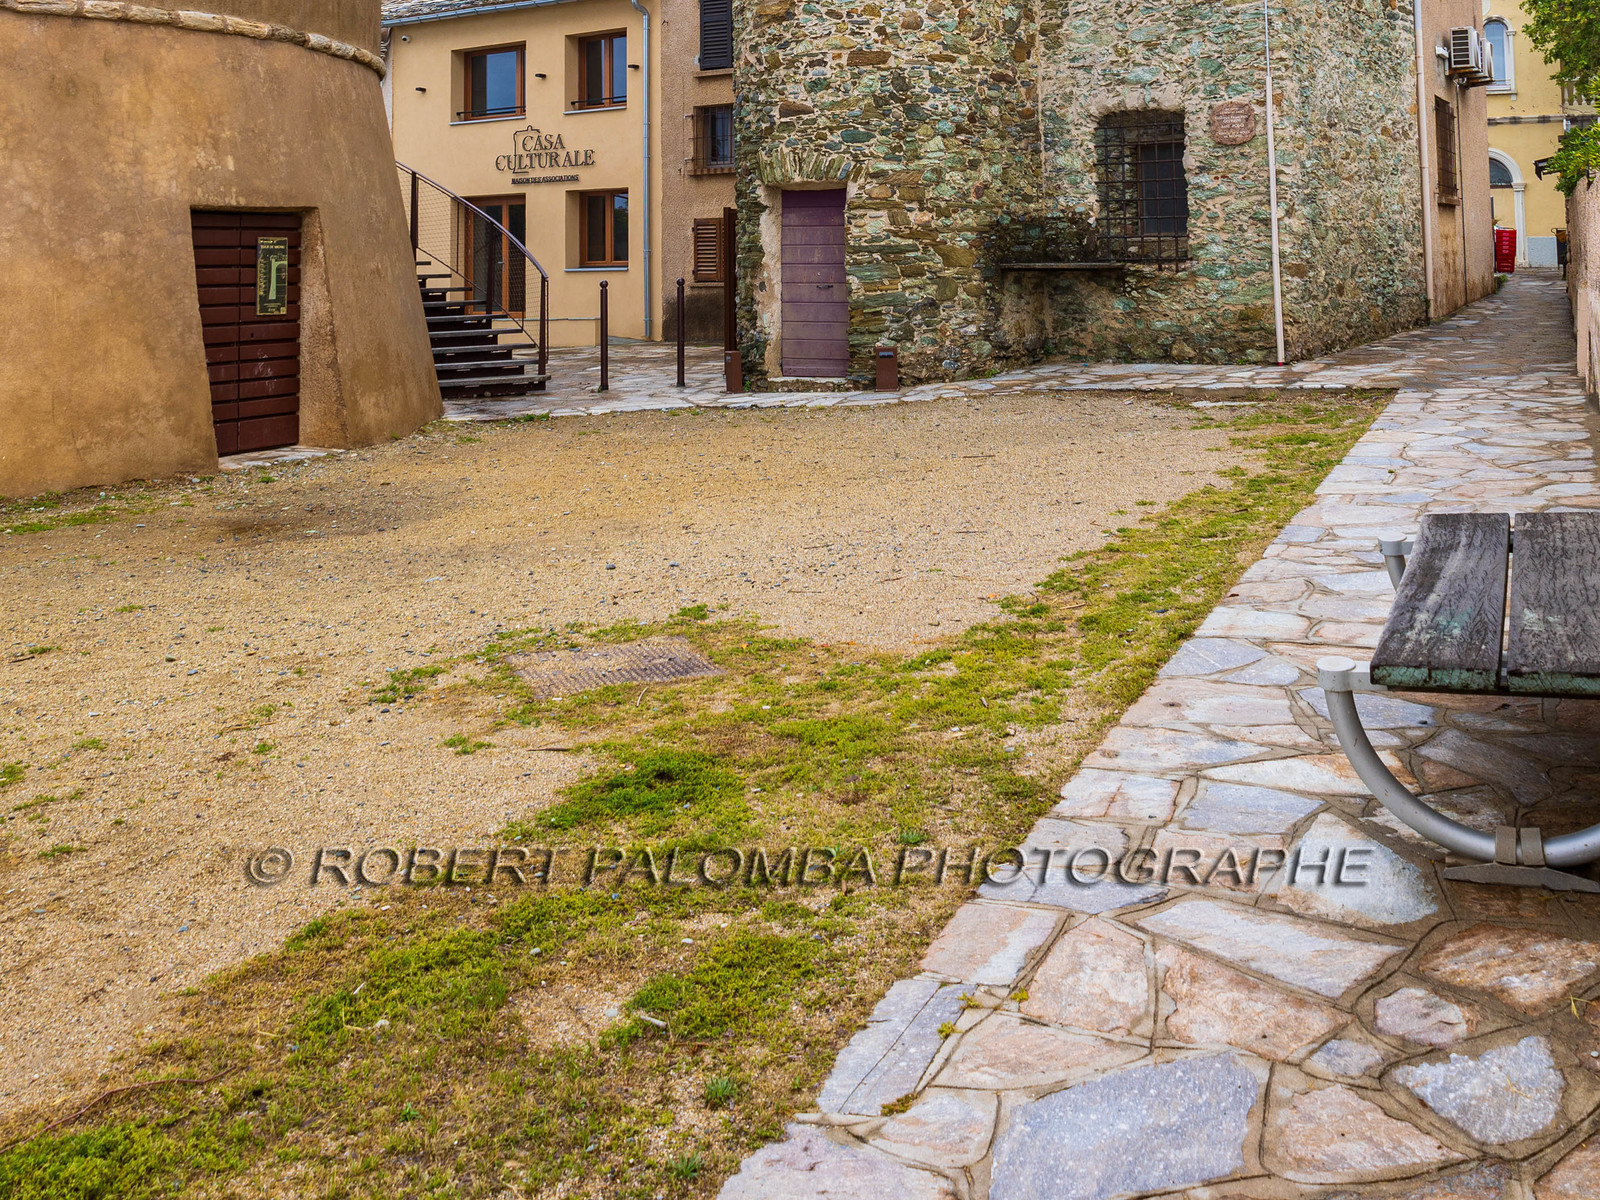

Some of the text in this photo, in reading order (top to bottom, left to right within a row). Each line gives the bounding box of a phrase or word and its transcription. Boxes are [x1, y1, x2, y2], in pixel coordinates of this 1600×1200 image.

[522, 134, 565, 152] CASA
[495, 149, 596, 171] CULTURALE
[542, 174, 579, 183] ASSOCIATIONS
